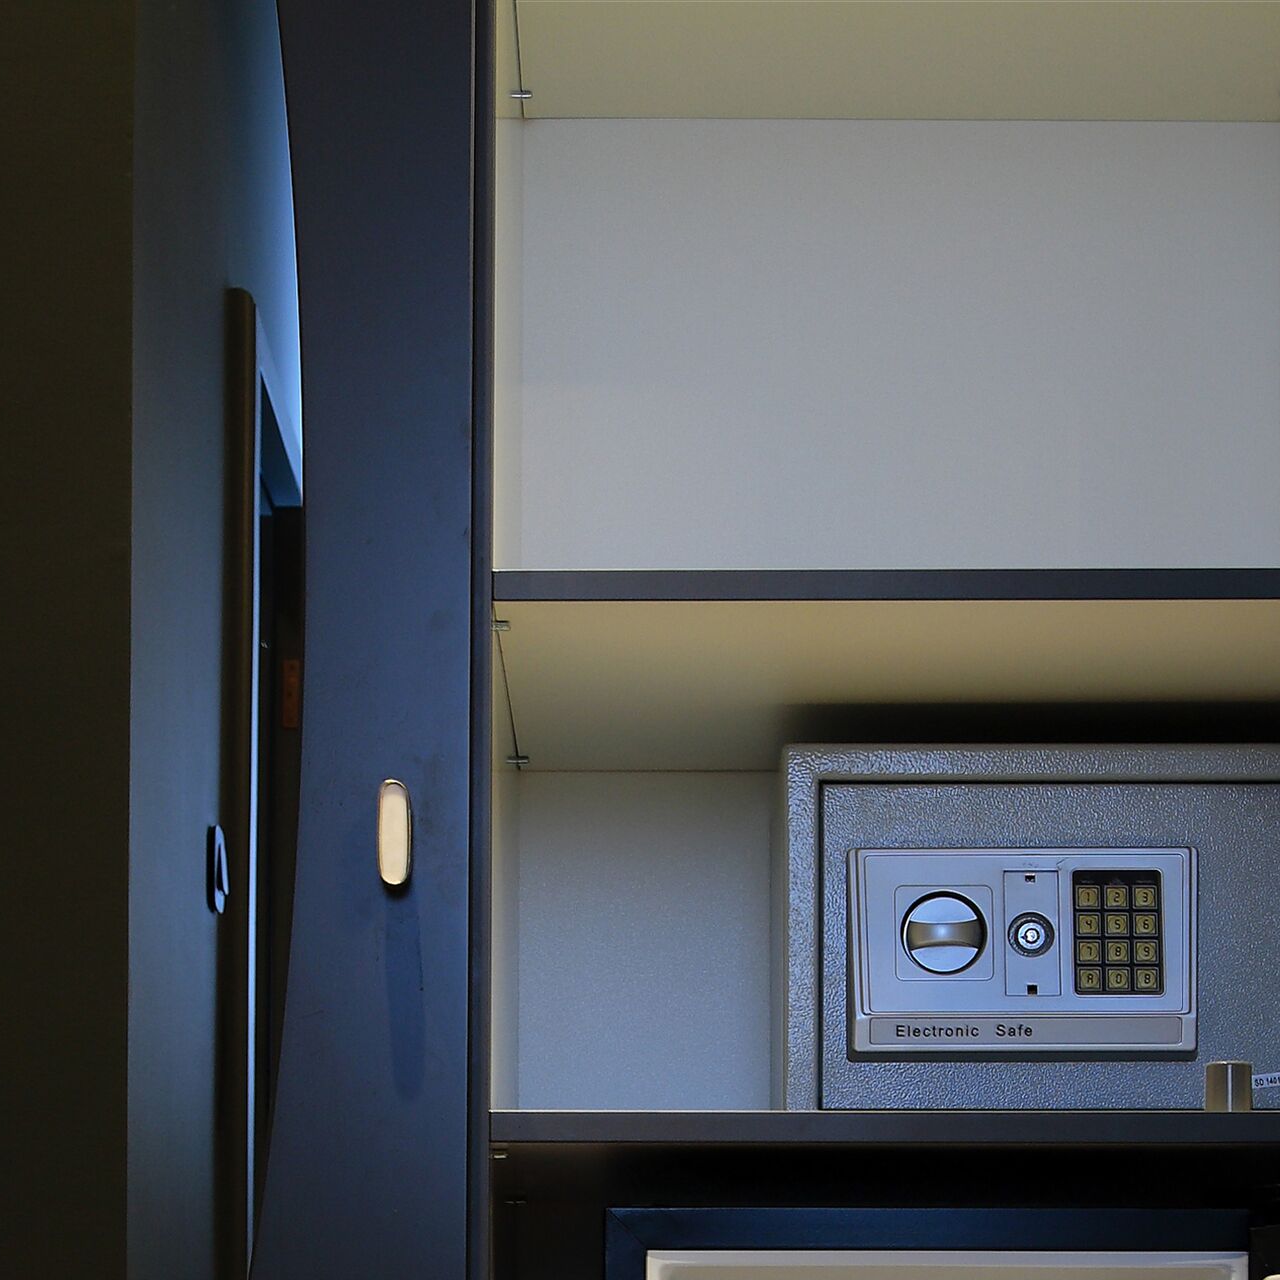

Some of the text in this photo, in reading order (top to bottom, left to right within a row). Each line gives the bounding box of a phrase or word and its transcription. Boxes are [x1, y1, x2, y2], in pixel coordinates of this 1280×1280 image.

[1143, 892, 1149, 902] 3
[1115, 919, 1121, 930] 5
[1143, 919, 1149, 929] 6
[1115, 946, 1121, 957] 8
[1144, 946, 1150, 957] 9
[1087, 973, 1093, 984] A
[896, 1024, 1033, 1037] Electronic Safe
